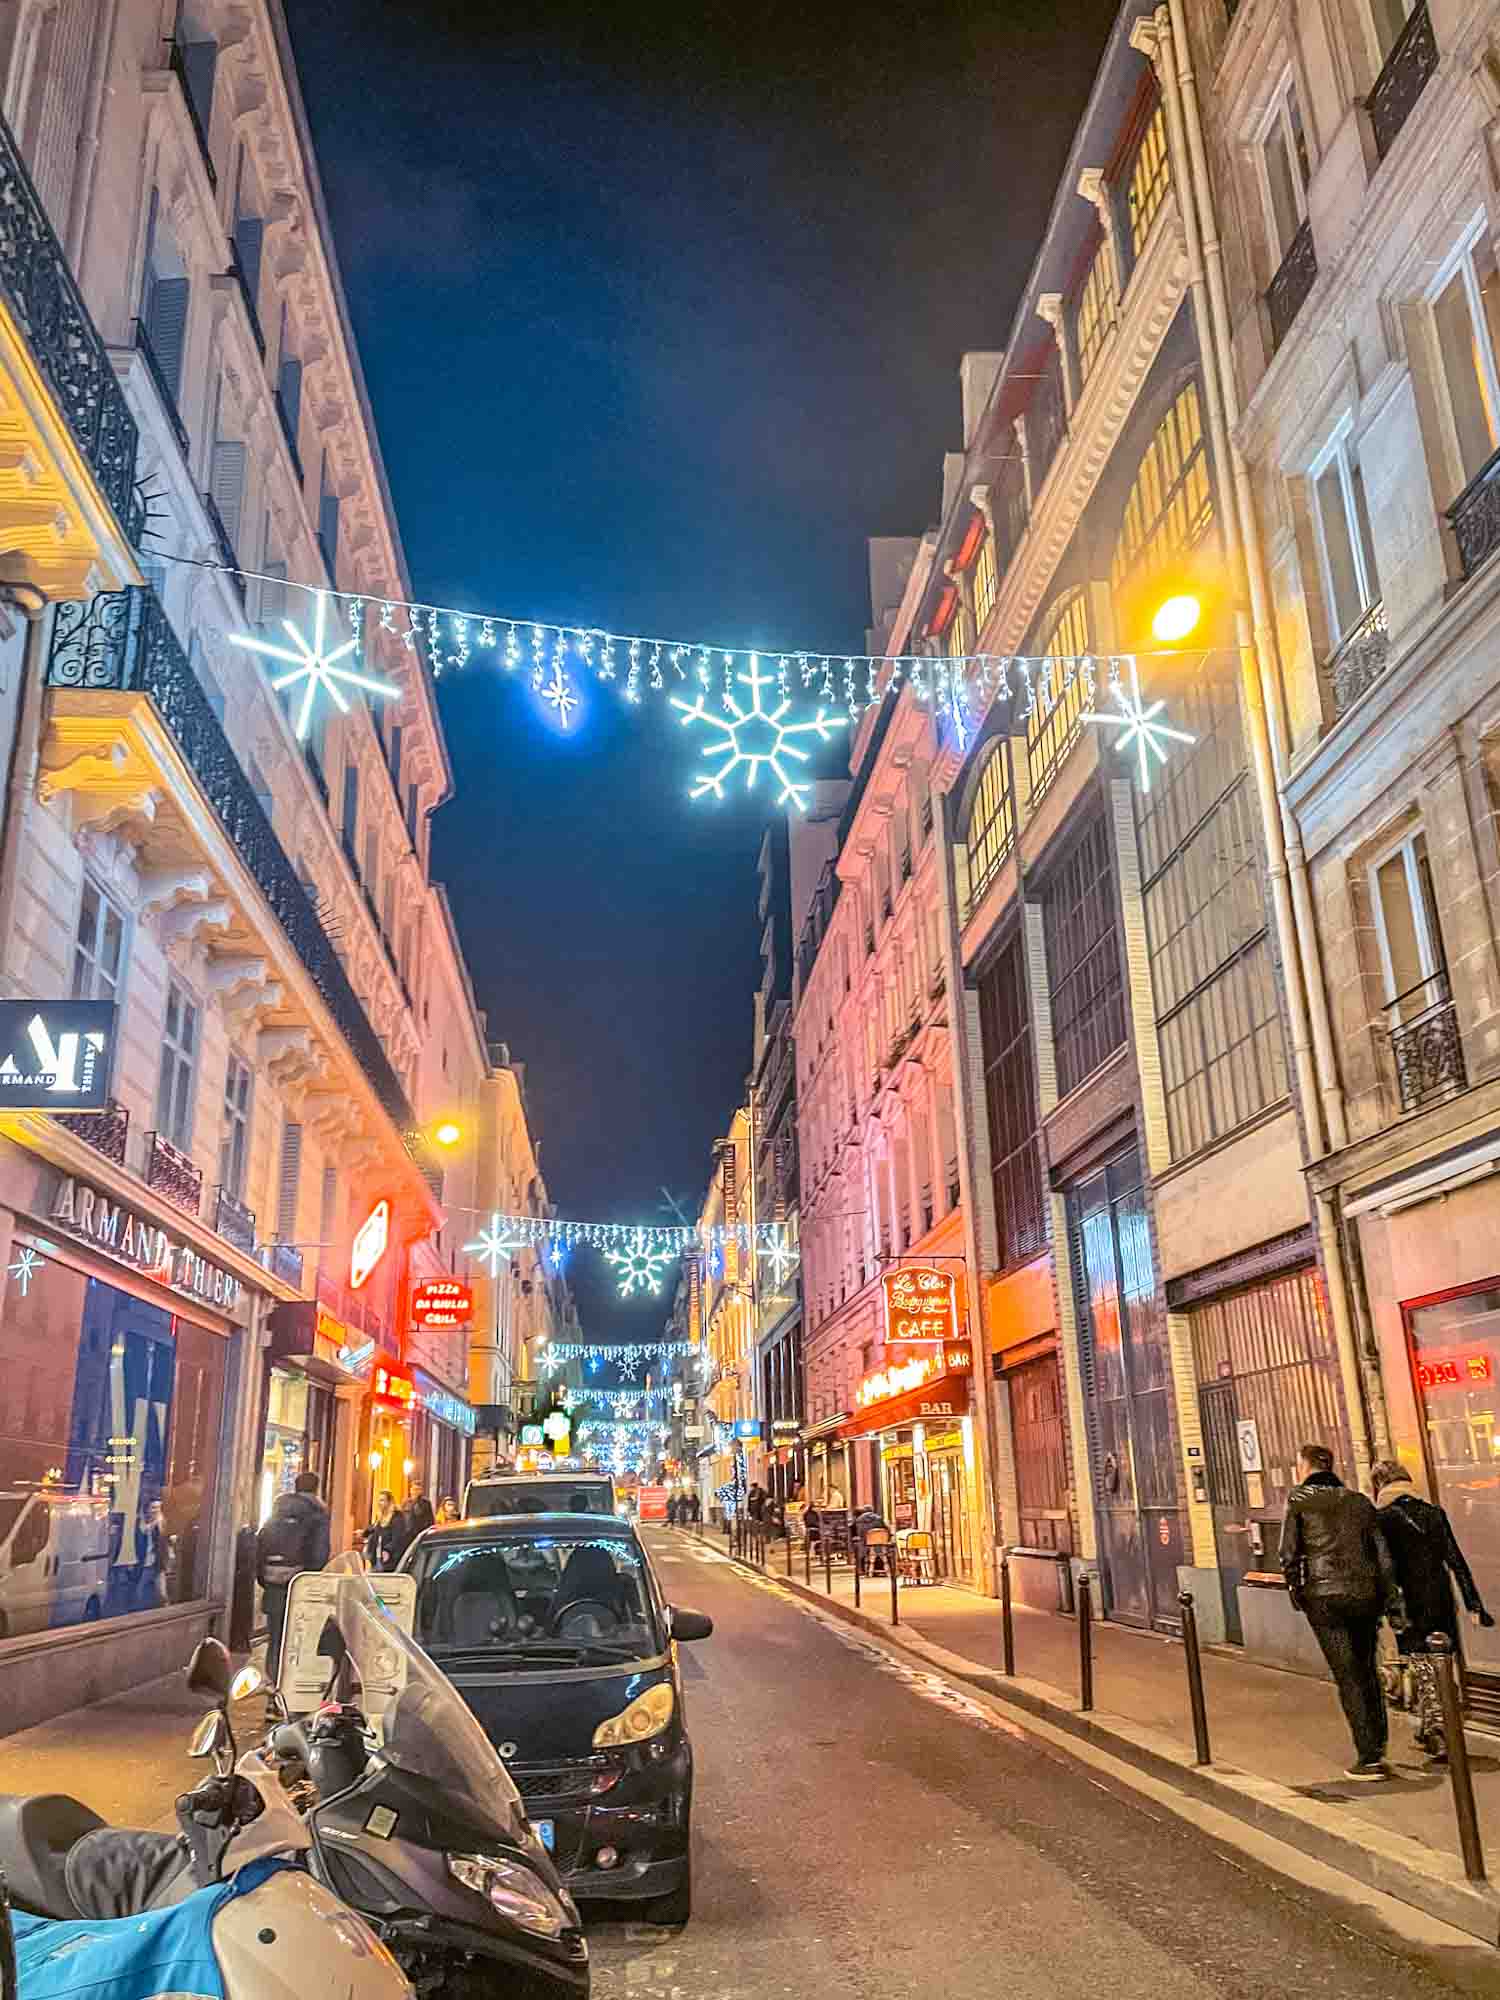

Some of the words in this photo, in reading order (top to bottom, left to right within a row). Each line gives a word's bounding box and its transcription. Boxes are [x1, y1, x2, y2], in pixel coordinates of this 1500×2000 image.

[81, 1042, 96, 1093] THIERY
[0, 1075, 56, 1085] RMAND
[50, 1178, 169, 1268] ARMAND
[180, 1247, 243, 1305] THIERY
[426, 1283, 460, 1296] PIZZA
[893, 1273, 915, 1292] Le
[432, 1299, 469, 1309] GIULIA
[425, 1312, 457, 1324] GRILL
[897, 1319, 944, 1337] CAFE
[948, 1352, 970, 1368] BAR
[919, 1401, 953, 1415] BAR
